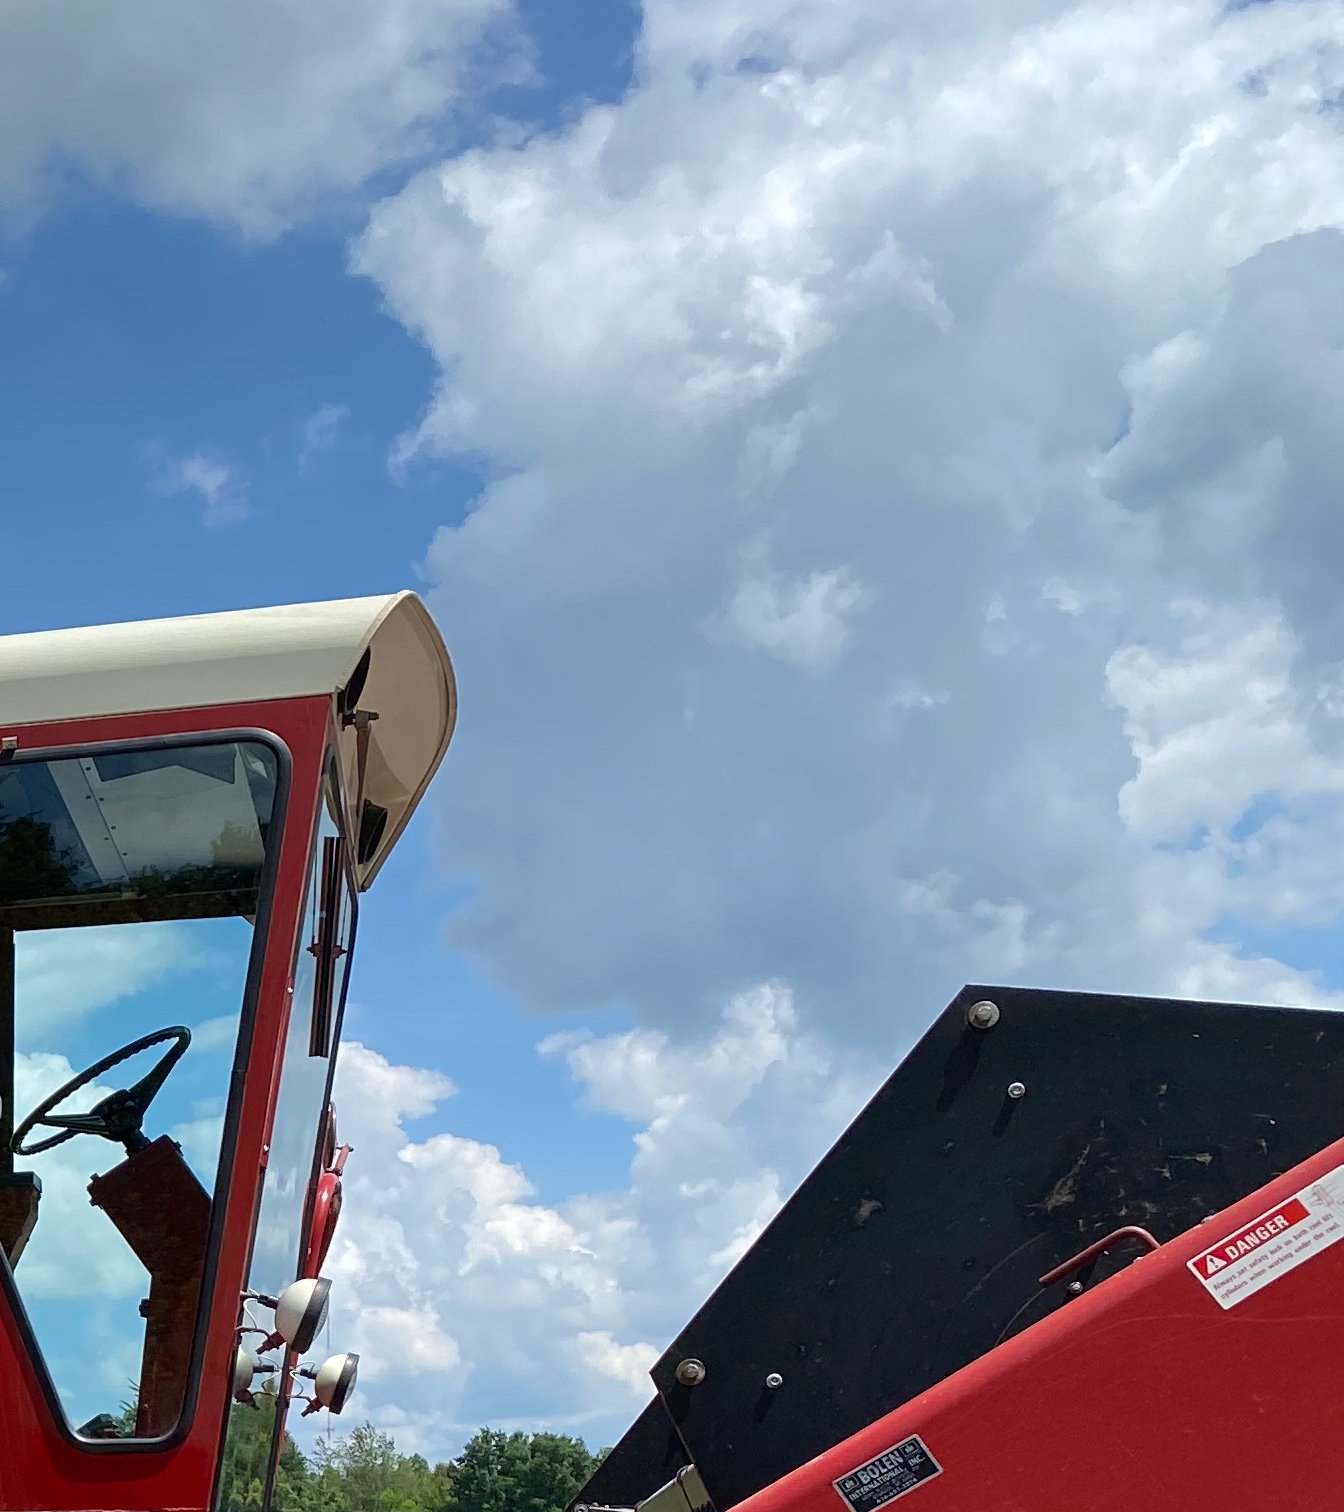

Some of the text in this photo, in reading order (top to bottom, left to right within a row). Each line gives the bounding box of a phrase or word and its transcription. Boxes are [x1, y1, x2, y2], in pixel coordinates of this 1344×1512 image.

[1224, 1214, 1290, 1260] DANGER
[849, 1466, 904, 1501] INTERNATIONAL
[857, 1450, 904, 1484] BOLEN
